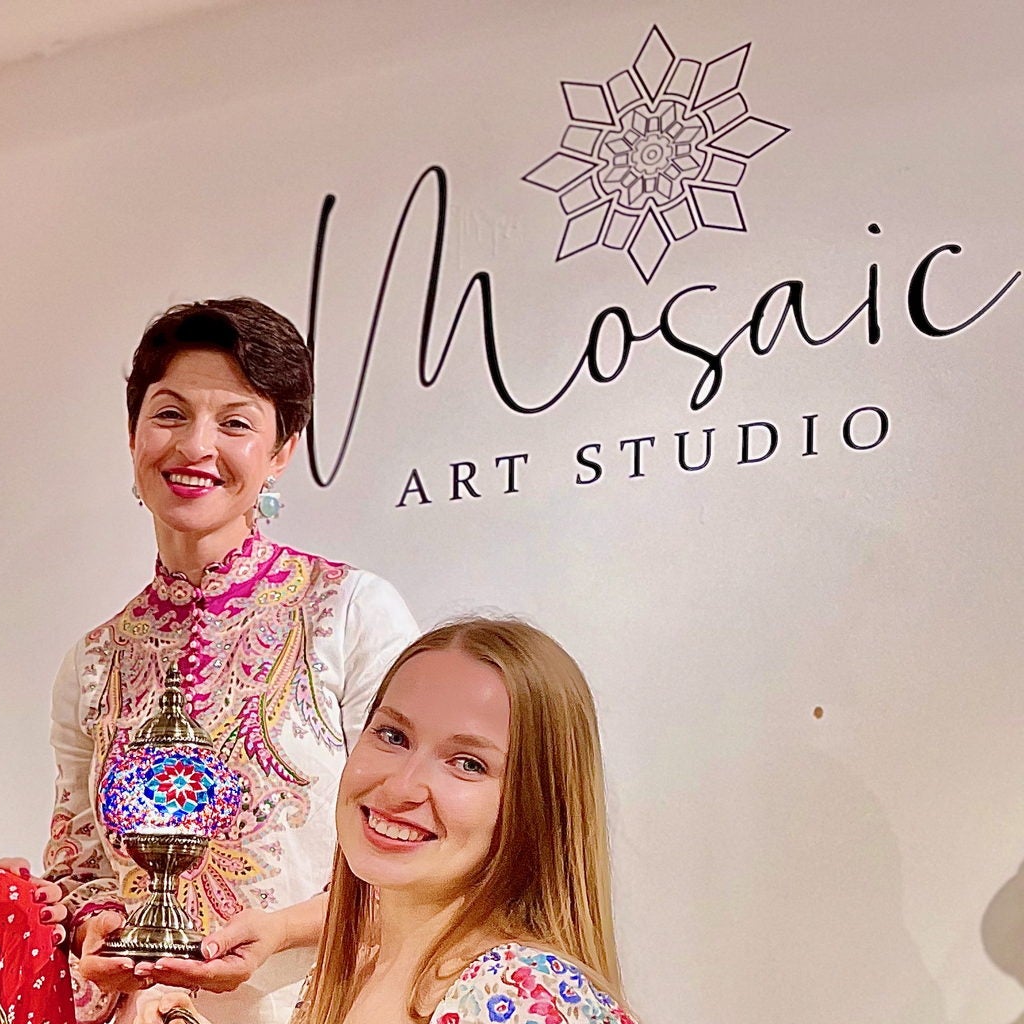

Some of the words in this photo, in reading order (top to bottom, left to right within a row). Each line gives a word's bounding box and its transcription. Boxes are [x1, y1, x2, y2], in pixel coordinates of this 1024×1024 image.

[306, 165, 1022, 488] Mosaic
[395, 453, 529, 508] ART
[575, 406, 889, 485] STUDIO
